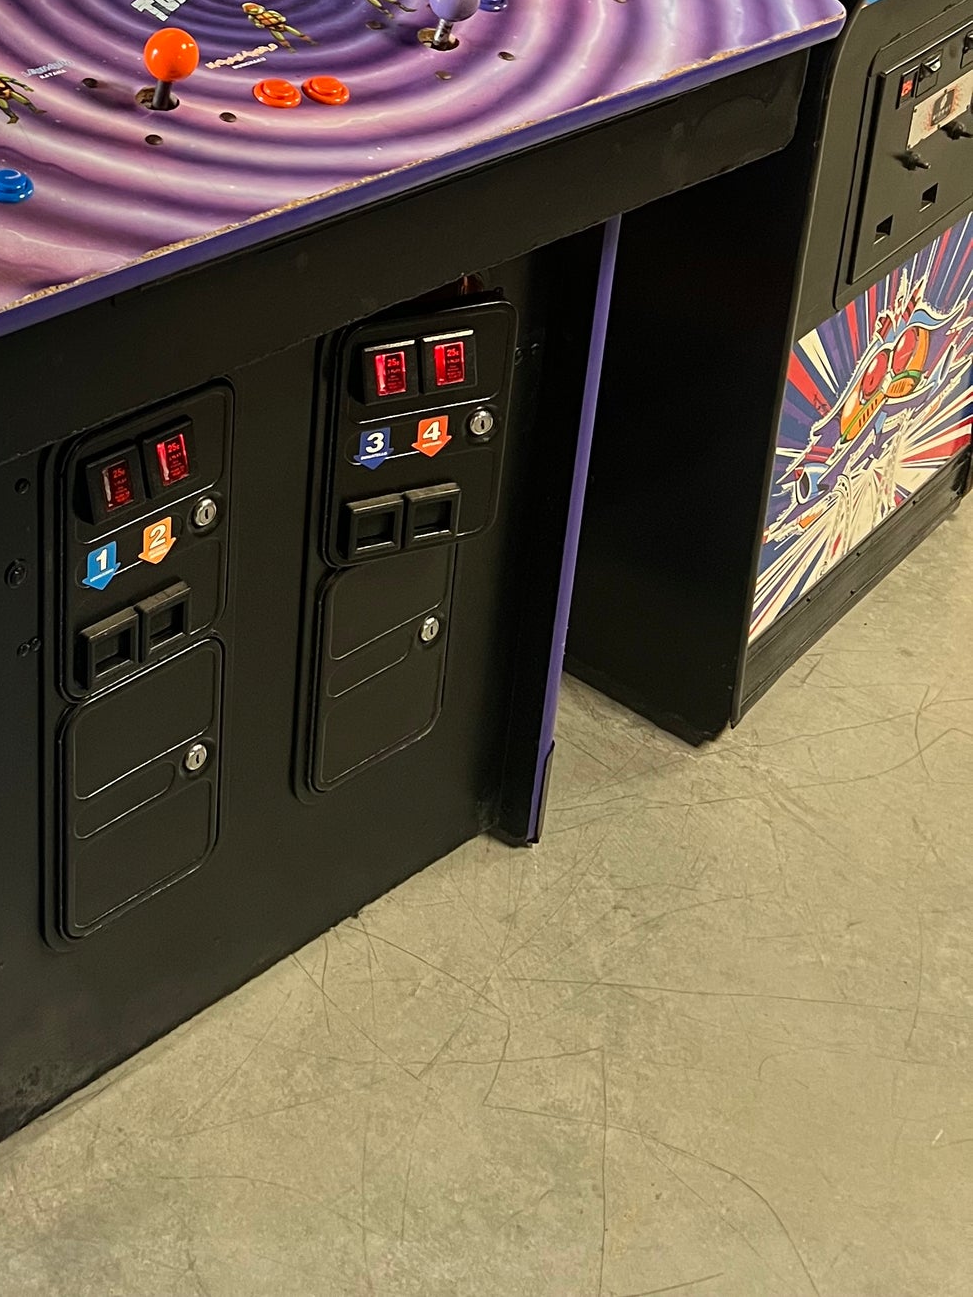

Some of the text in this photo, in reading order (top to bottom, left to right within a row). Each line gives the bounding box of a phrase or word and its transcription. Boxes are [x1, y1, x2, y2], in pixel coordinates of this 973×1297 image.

[422, 421, 442, 441] 4
[365, 432, 385, 454] 3
[149, 523, 167, 550] 2
[96, 548, 108, 571] 1
